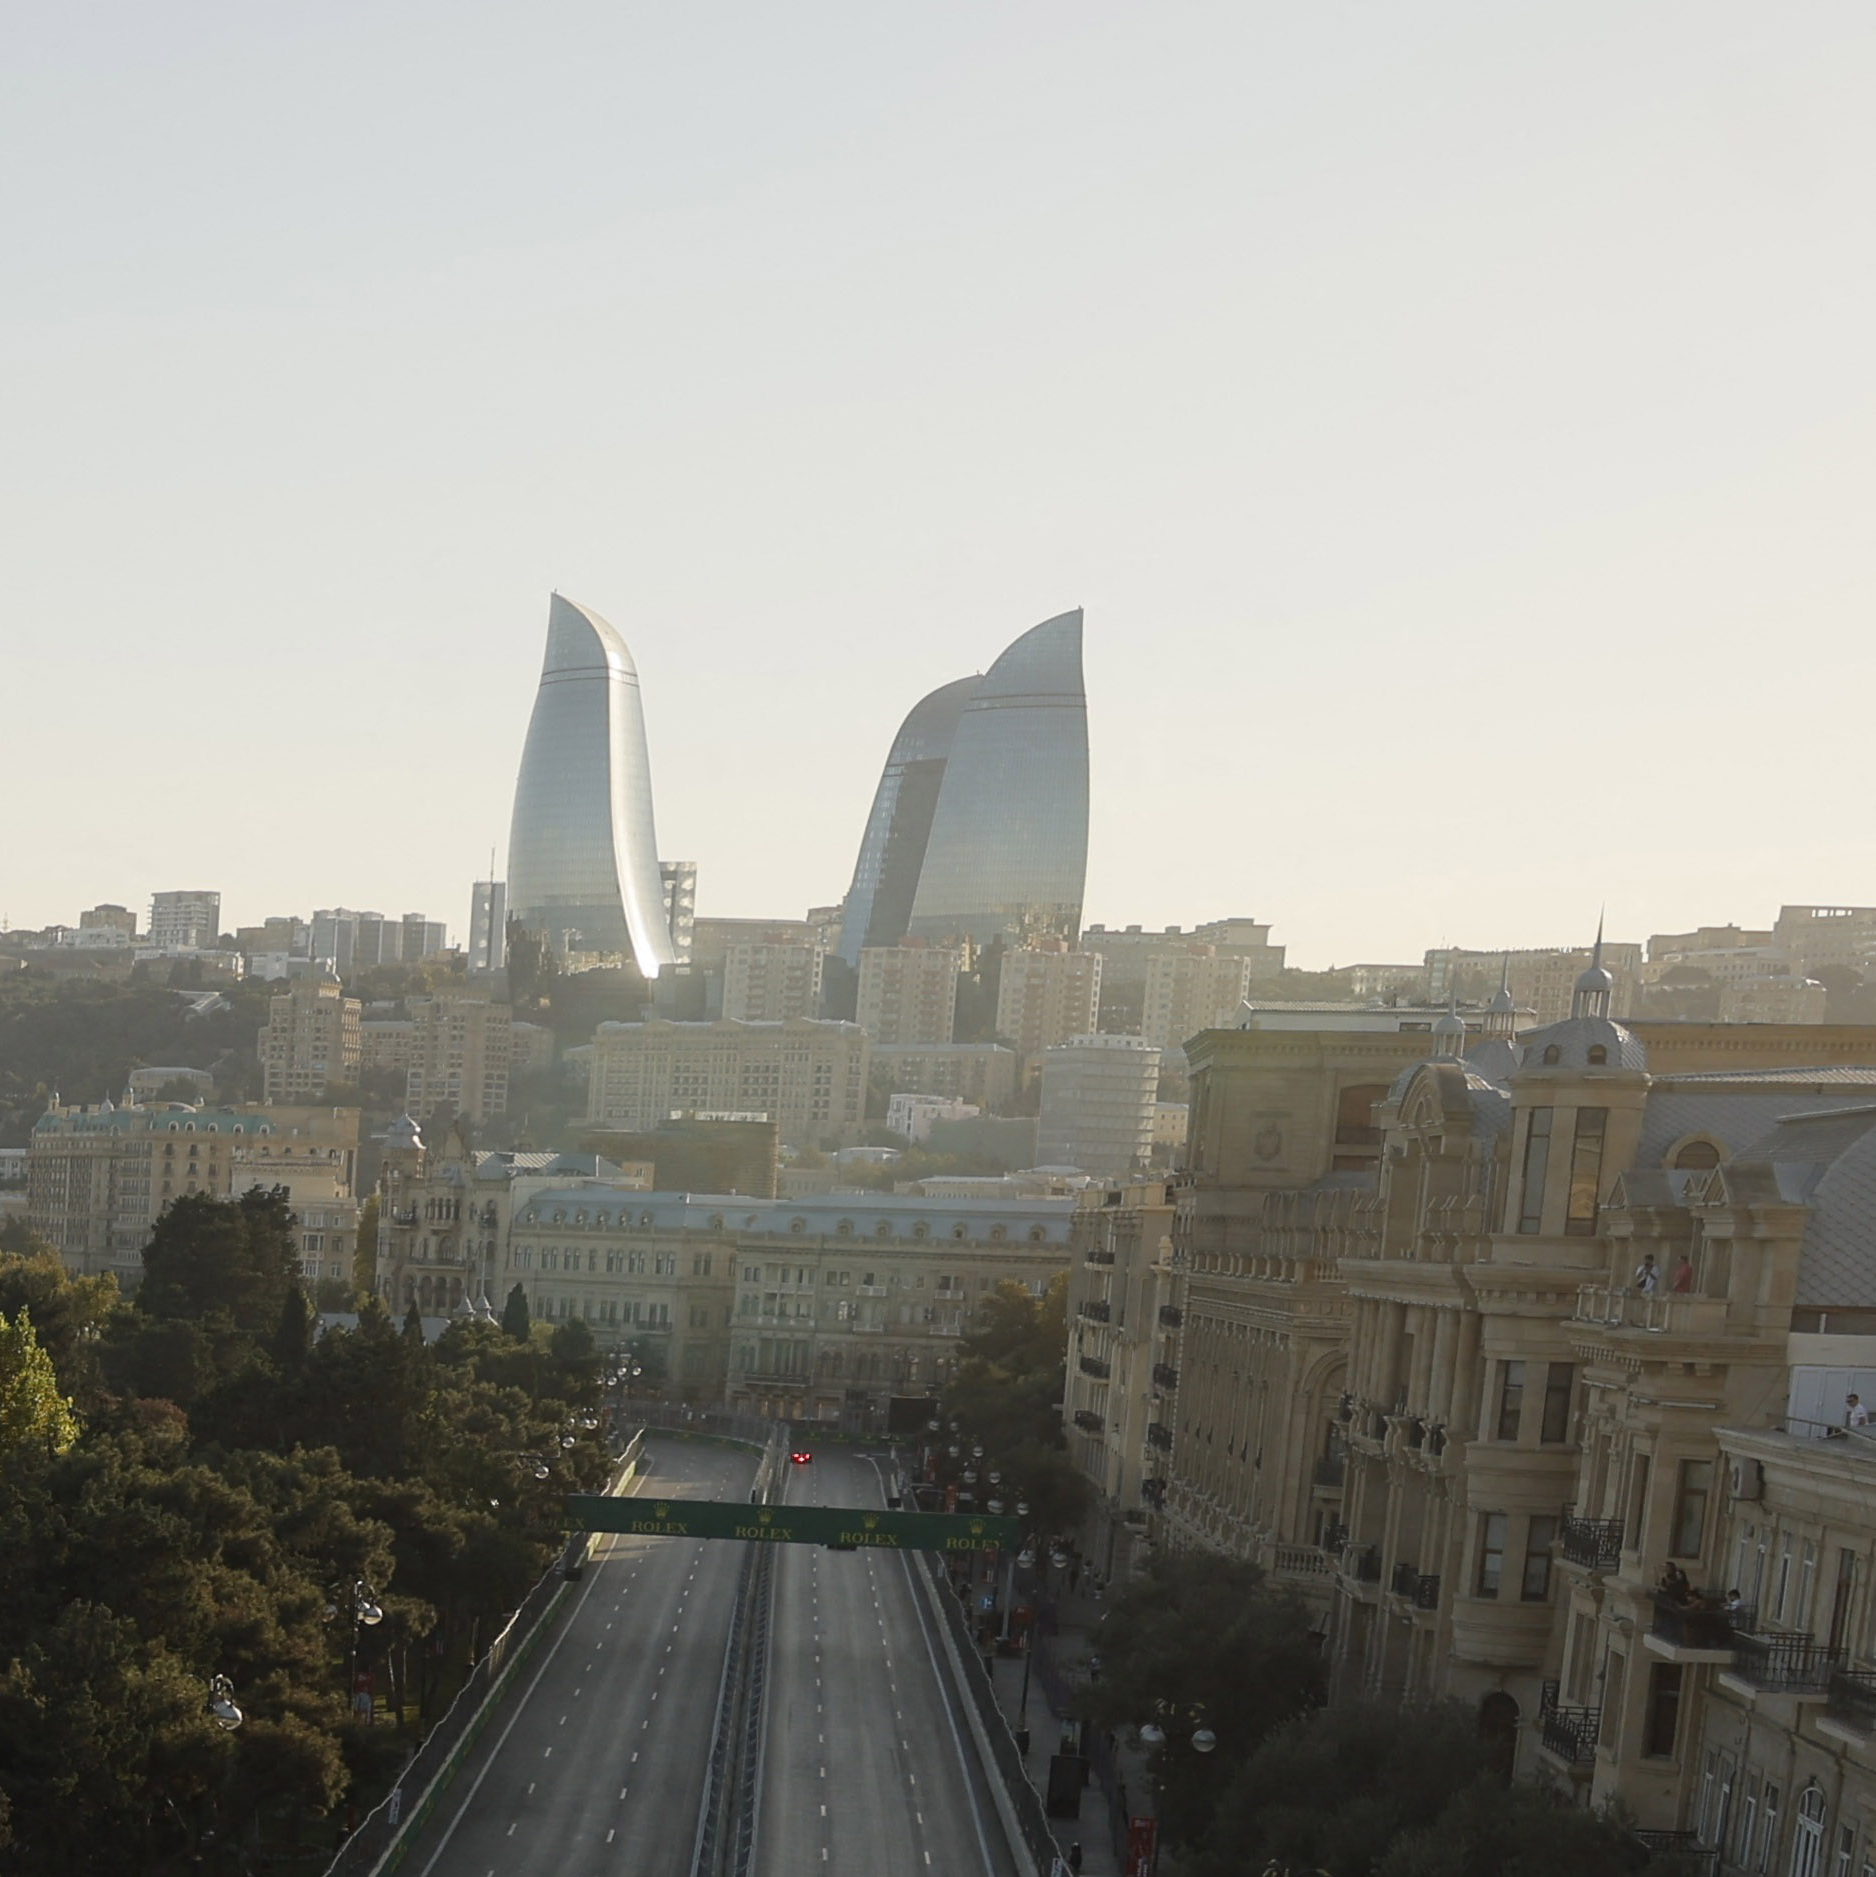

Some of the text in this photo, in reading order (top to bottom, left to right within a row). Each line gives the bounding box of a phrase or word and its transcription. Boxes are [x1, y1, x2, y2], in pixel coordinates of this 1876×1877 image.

[632, 1520, 688, 1535] ROLEX
[735, 1525, 792, 1540] ROLEX
[840, 1531, 898, 1546] ROLEX
